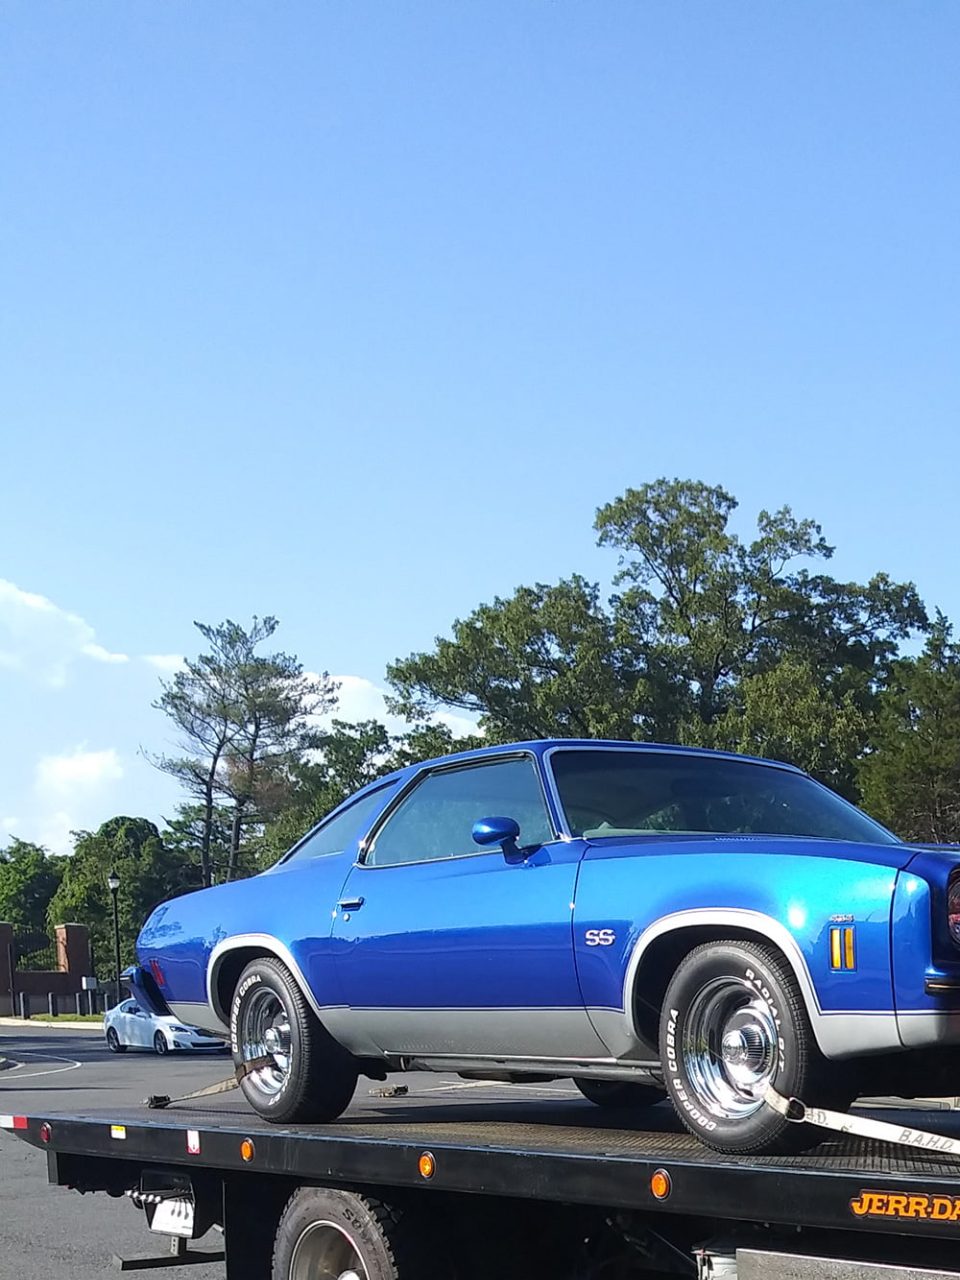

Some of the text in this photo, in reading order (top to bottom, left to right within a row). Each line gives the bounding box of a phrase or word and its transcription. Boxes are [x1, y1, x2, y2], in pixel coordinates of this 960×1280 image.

[585, 929, 615, 946] SS
[231, 974, 262, 1053] COOPER COBRA
[745, 969, 780, 1027] RADIAL
[666, 1008, 717, 1131] COOPER COBRA
